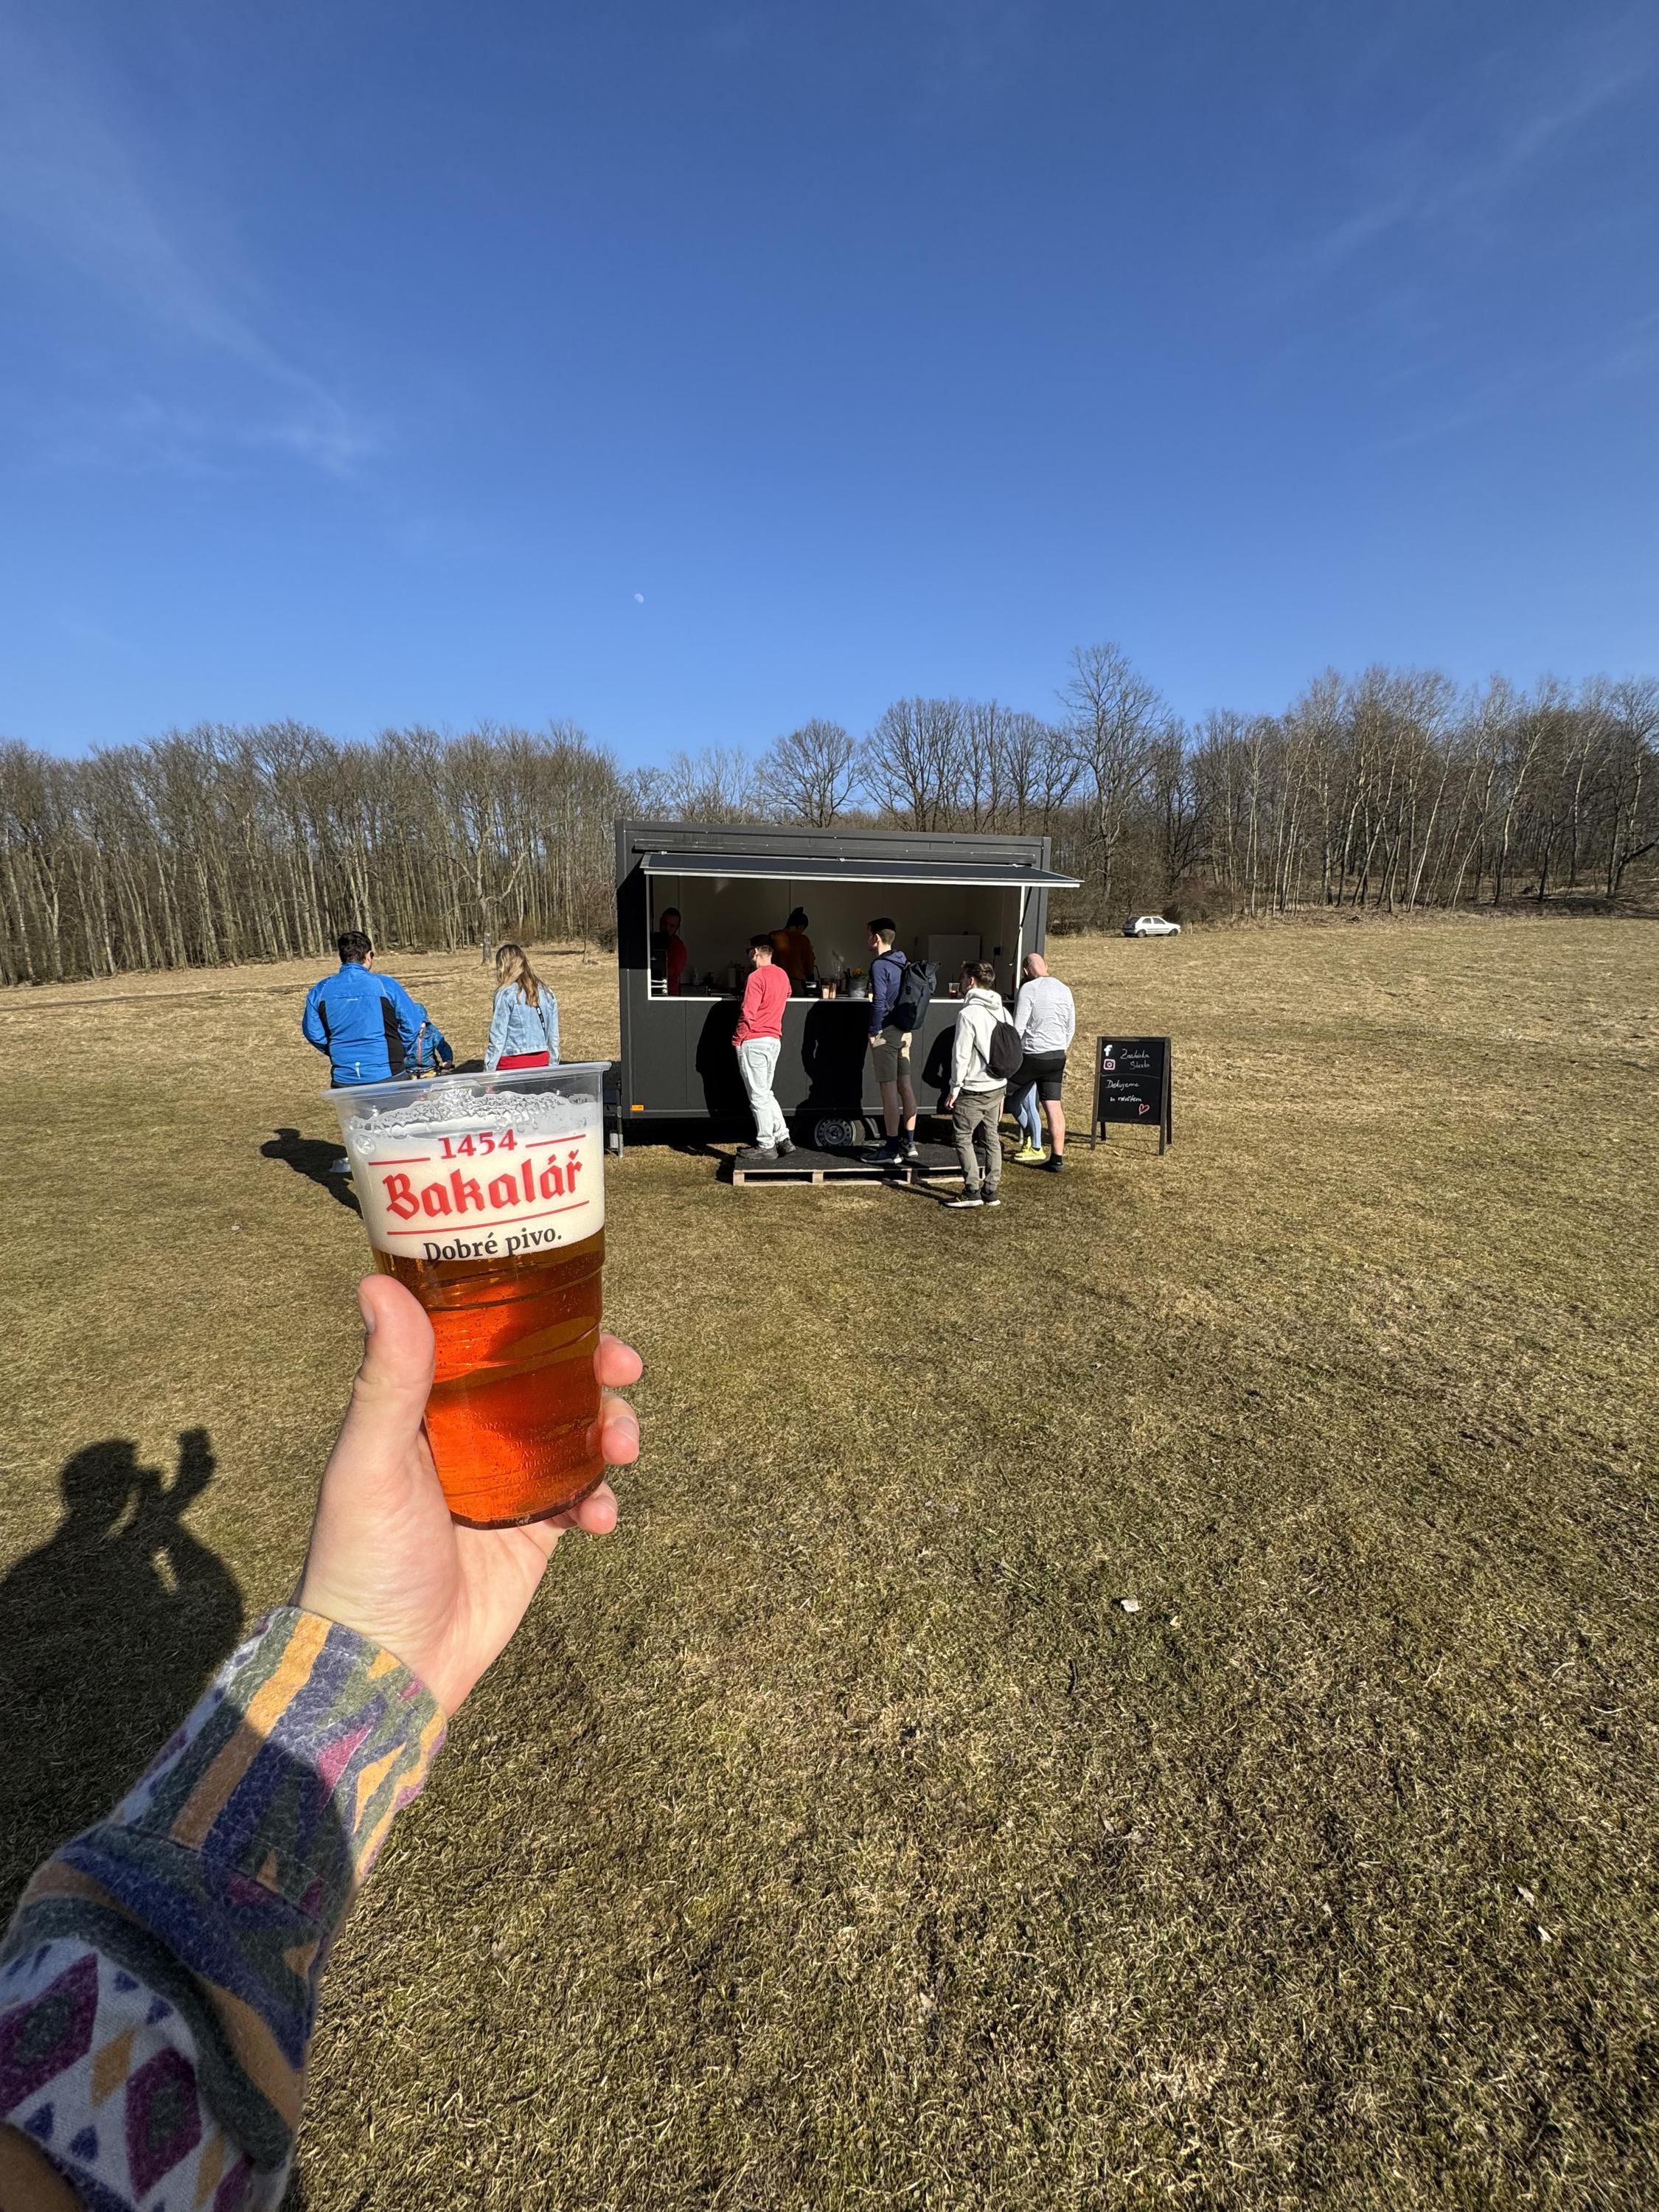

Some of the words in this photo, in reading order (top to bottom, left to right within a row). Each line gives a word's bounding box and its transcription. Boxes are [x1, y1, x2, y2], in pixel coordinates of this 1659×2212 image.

[437, 1129, 518, 1160] 1454
[382, 1149, 582, 1220] Bakalář
[423, 1232, 498, 1261] Dobré
[505, 1227, 562, 1256] pivo.
